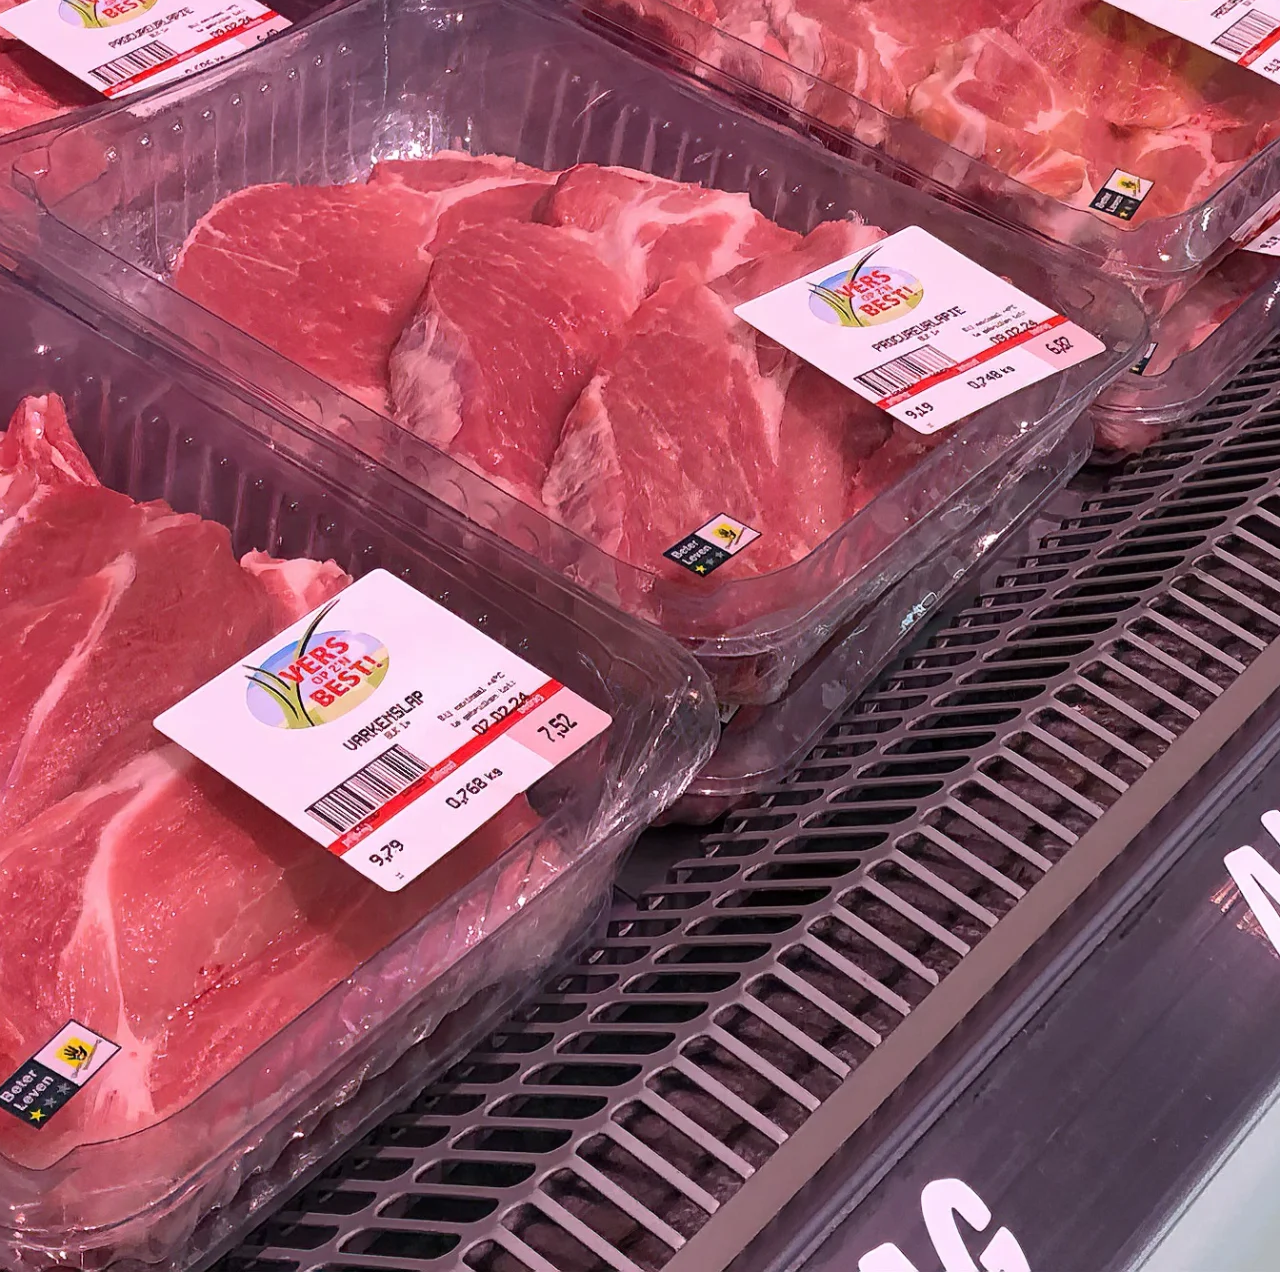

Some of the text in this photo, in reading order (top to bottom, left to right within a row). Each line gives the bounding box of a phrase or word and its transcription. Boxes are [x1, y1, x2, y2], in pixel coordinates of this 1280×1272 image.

[835, 270, 892, 299] VERS
[859, 285, 918, 317] BEST!
[670, 539, 699, 559] Beter
[278, 636, 350, 684] VERS
[309, 655, 383, 708] BEST!
[311, 671, 329, 685] OP
[342, 690, 424, 751] VARKENSLAP
[0, 1068, 38, 1103] Beter
[13, 1075, 54, 1112] Leven
